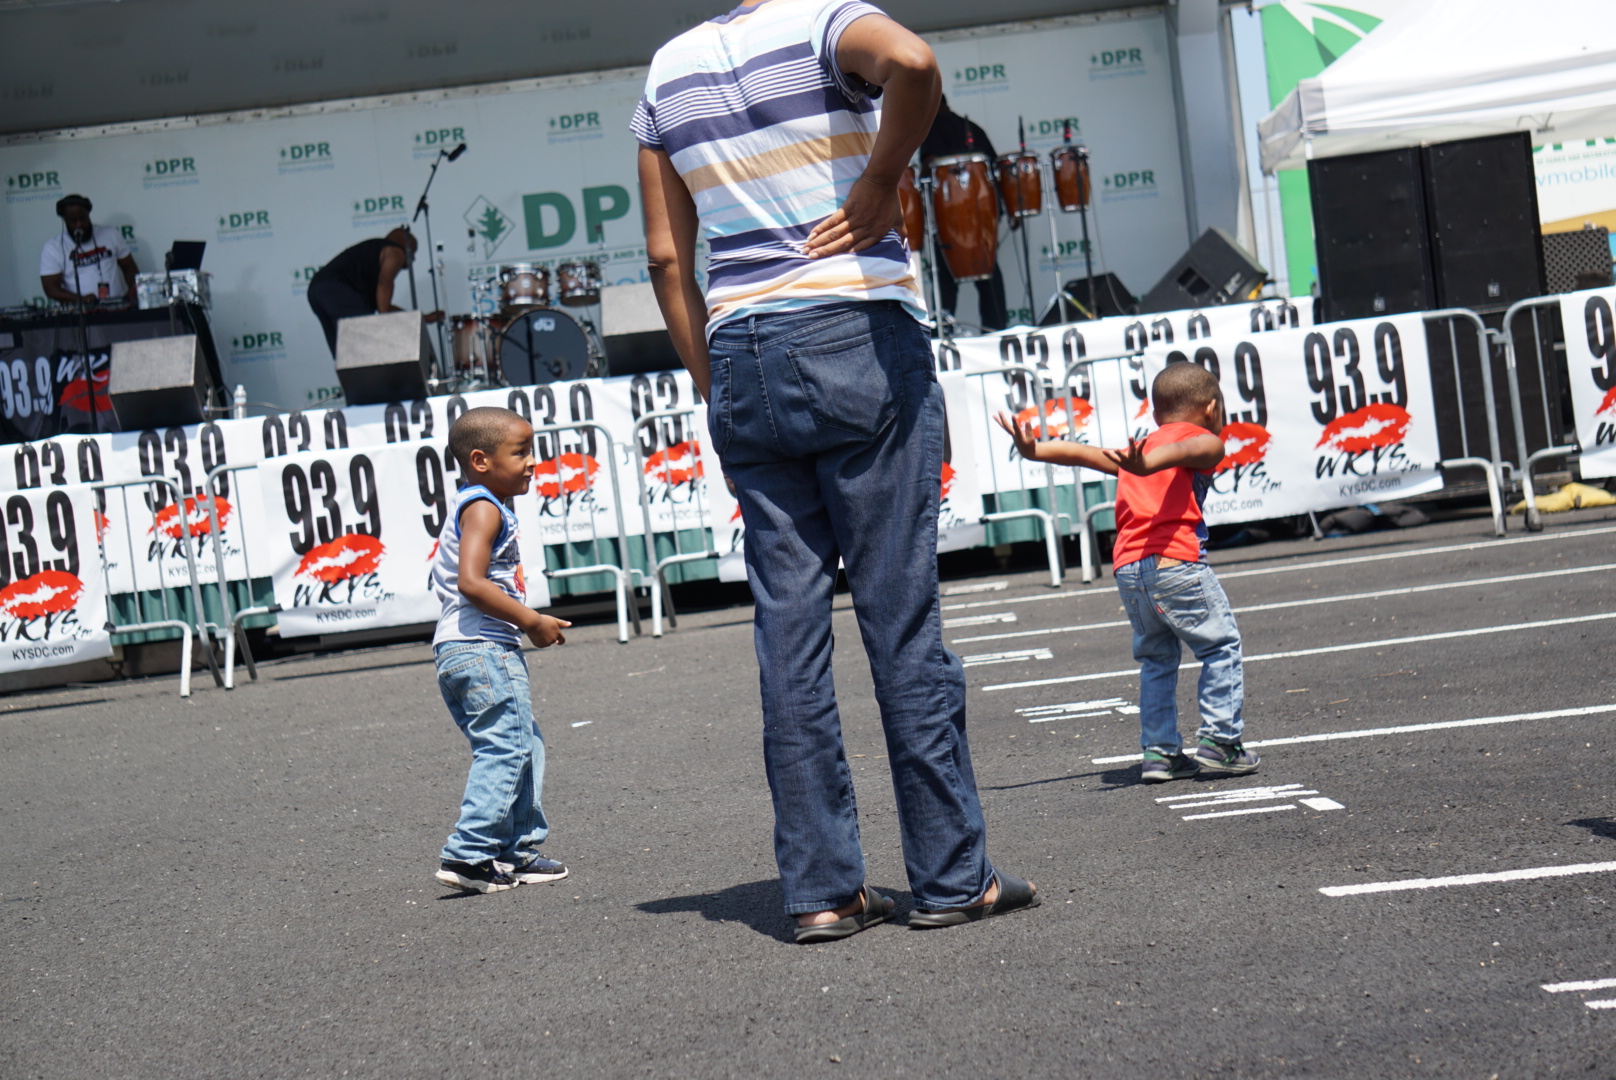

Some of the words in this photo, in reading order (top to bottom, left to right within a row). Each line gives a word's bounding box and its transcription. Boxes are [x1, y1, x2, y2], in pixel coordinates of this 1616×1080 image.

[1101, 48, 1142, 66] DPR
[964, 64, 1006, 82] DPR
[558, 112, 600, 129] DPR
[425, 126, 465, 144] DPR
[289, 142, 331, 159] DPR
[155, 157, 197, 174] DPR
[17, 171, 60, 188] DPR
[1114, 171, 1156, 188] DPR
[363, 195, 405, 213] DPR
[229, 211, 270, 228] DPR
[522, 184, 647, 251] DP
[242, 332, 284, 349] DPR
[1304, 321, 1408, 426] 93.9
[1316, 442, 1406, 479] WKYS
[1339, 475, 1402, 497] KYSDC.com
[282, 454, 381, 556] 93.9
[293, 572, 381, 608] WKYS
[316, 608, 378, 624] KYSDC.com
[12, 643, 75, 662] KYSDC.com
